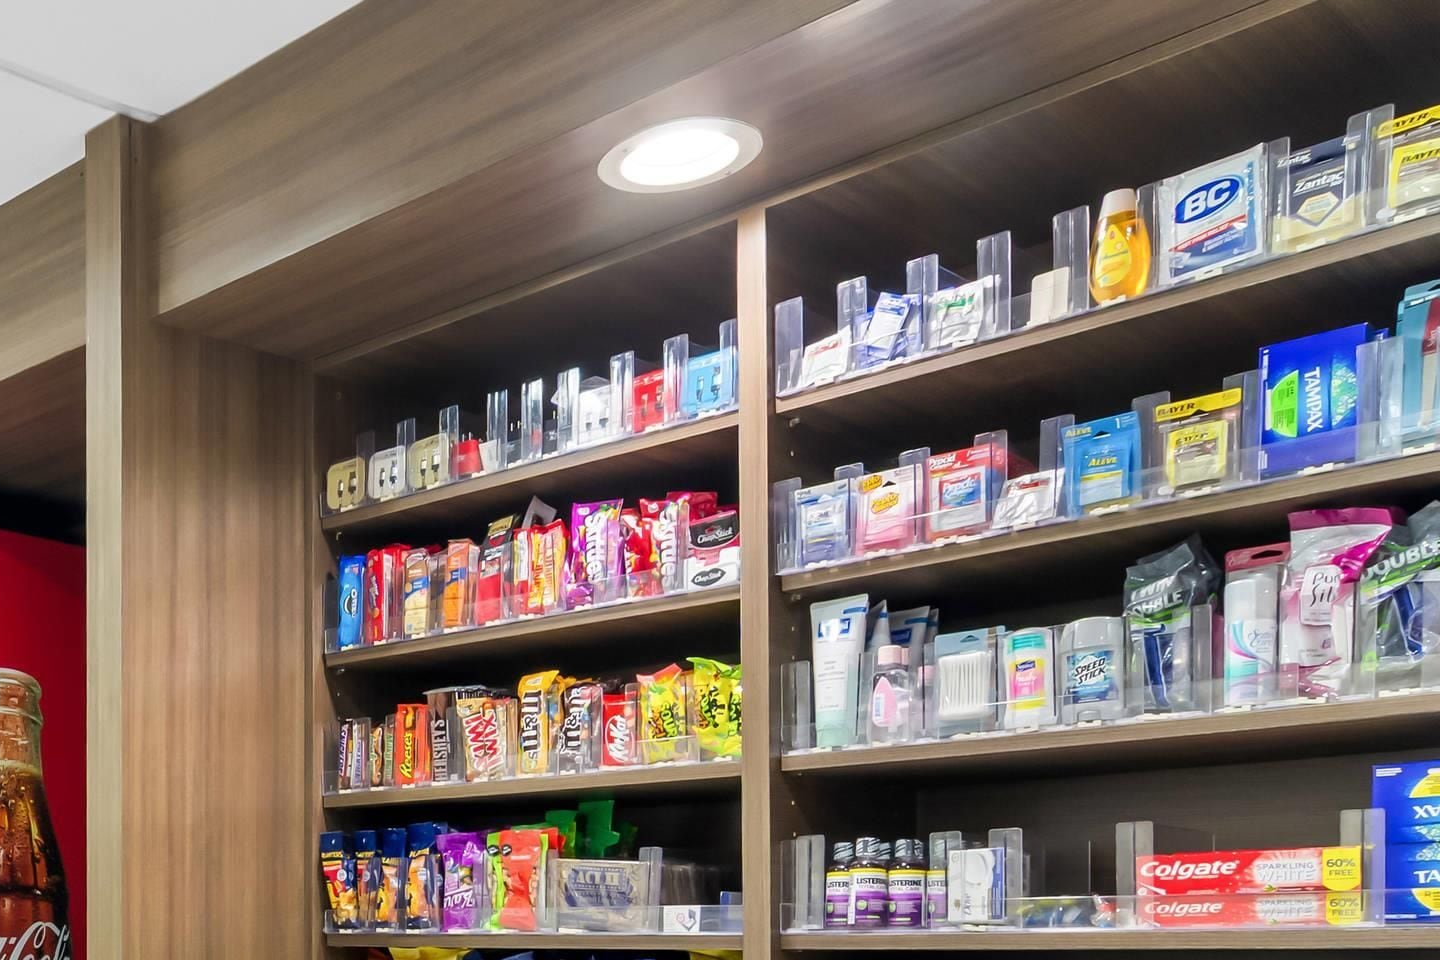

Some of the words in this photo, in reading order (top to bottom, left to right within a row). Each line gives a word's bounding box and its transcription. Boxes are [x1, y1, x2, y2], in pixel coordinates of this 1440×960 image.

[1293, 171, 1345, 194] Zantac
[1183, 180, 1231, 221] BC
[1303, 366, 1324, 433] TAMPAX
[1074, 657, 1106, 677] SPEED
[1078, 666, 1106, 685] STICK
[1140, 859, 1239, 880] Colgate
[1255, 860, 1315, 871] SPARKLING
[1325, 858, 1356, 869] 60%
[575, 871, 601, 884] ACT
[1257, 870, 1316, 882] WHITE
[1328, 869, 1353, 877] FREE
[1144, 901, 1224, 917] Colgate
[1329, 898, 1360, 909] 60%
